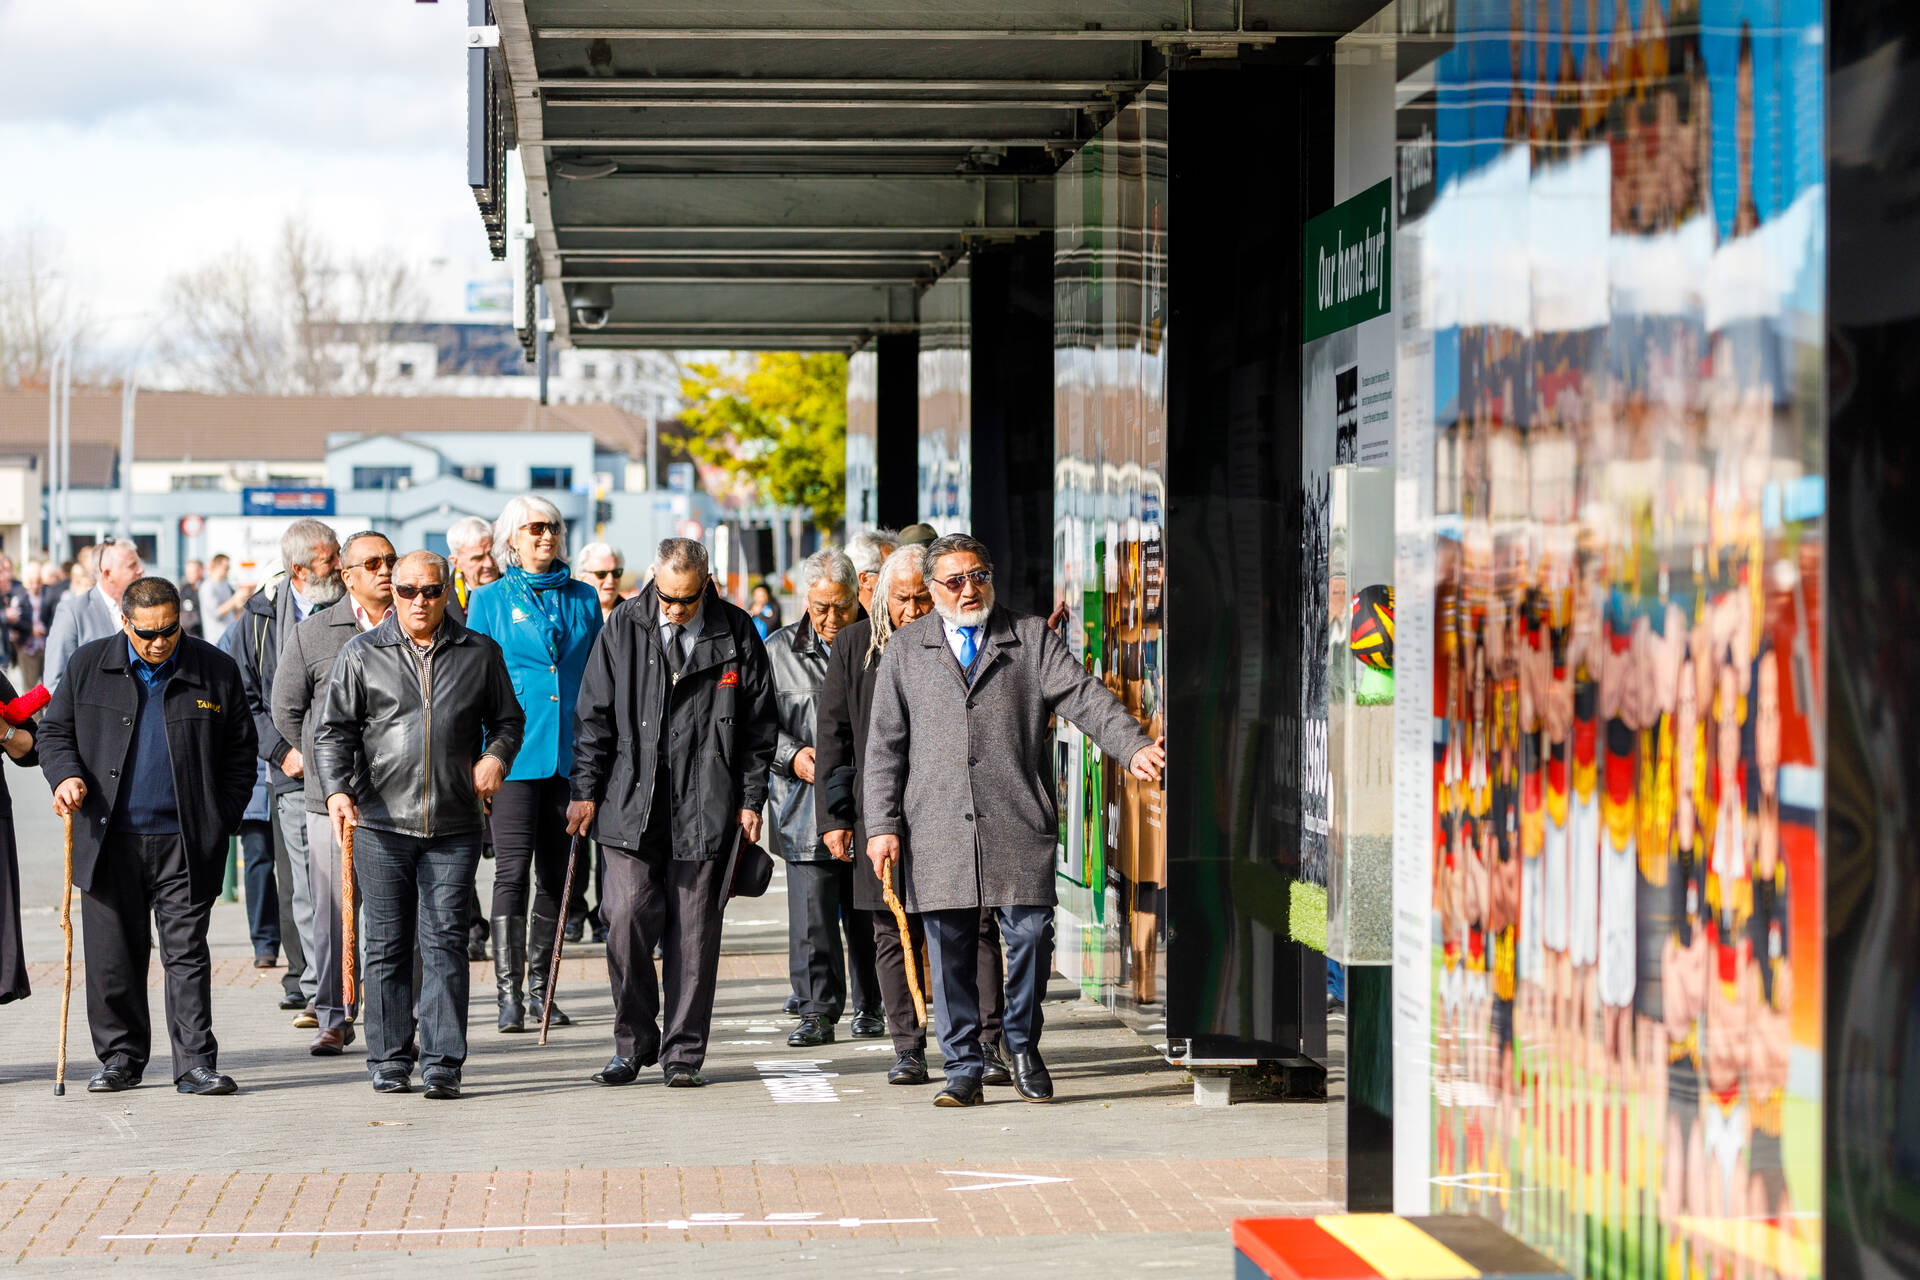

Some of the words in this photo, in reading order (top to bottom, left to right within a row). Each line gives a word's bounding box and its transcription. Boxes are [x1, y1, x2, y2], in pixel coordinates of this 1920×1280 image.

[1318, 246, 1336, 311] Our
[1337, 230, 1364, 303] home
[1366, 207, 1386, 310] turf
[1305, 718, 1328, 797] 1960
